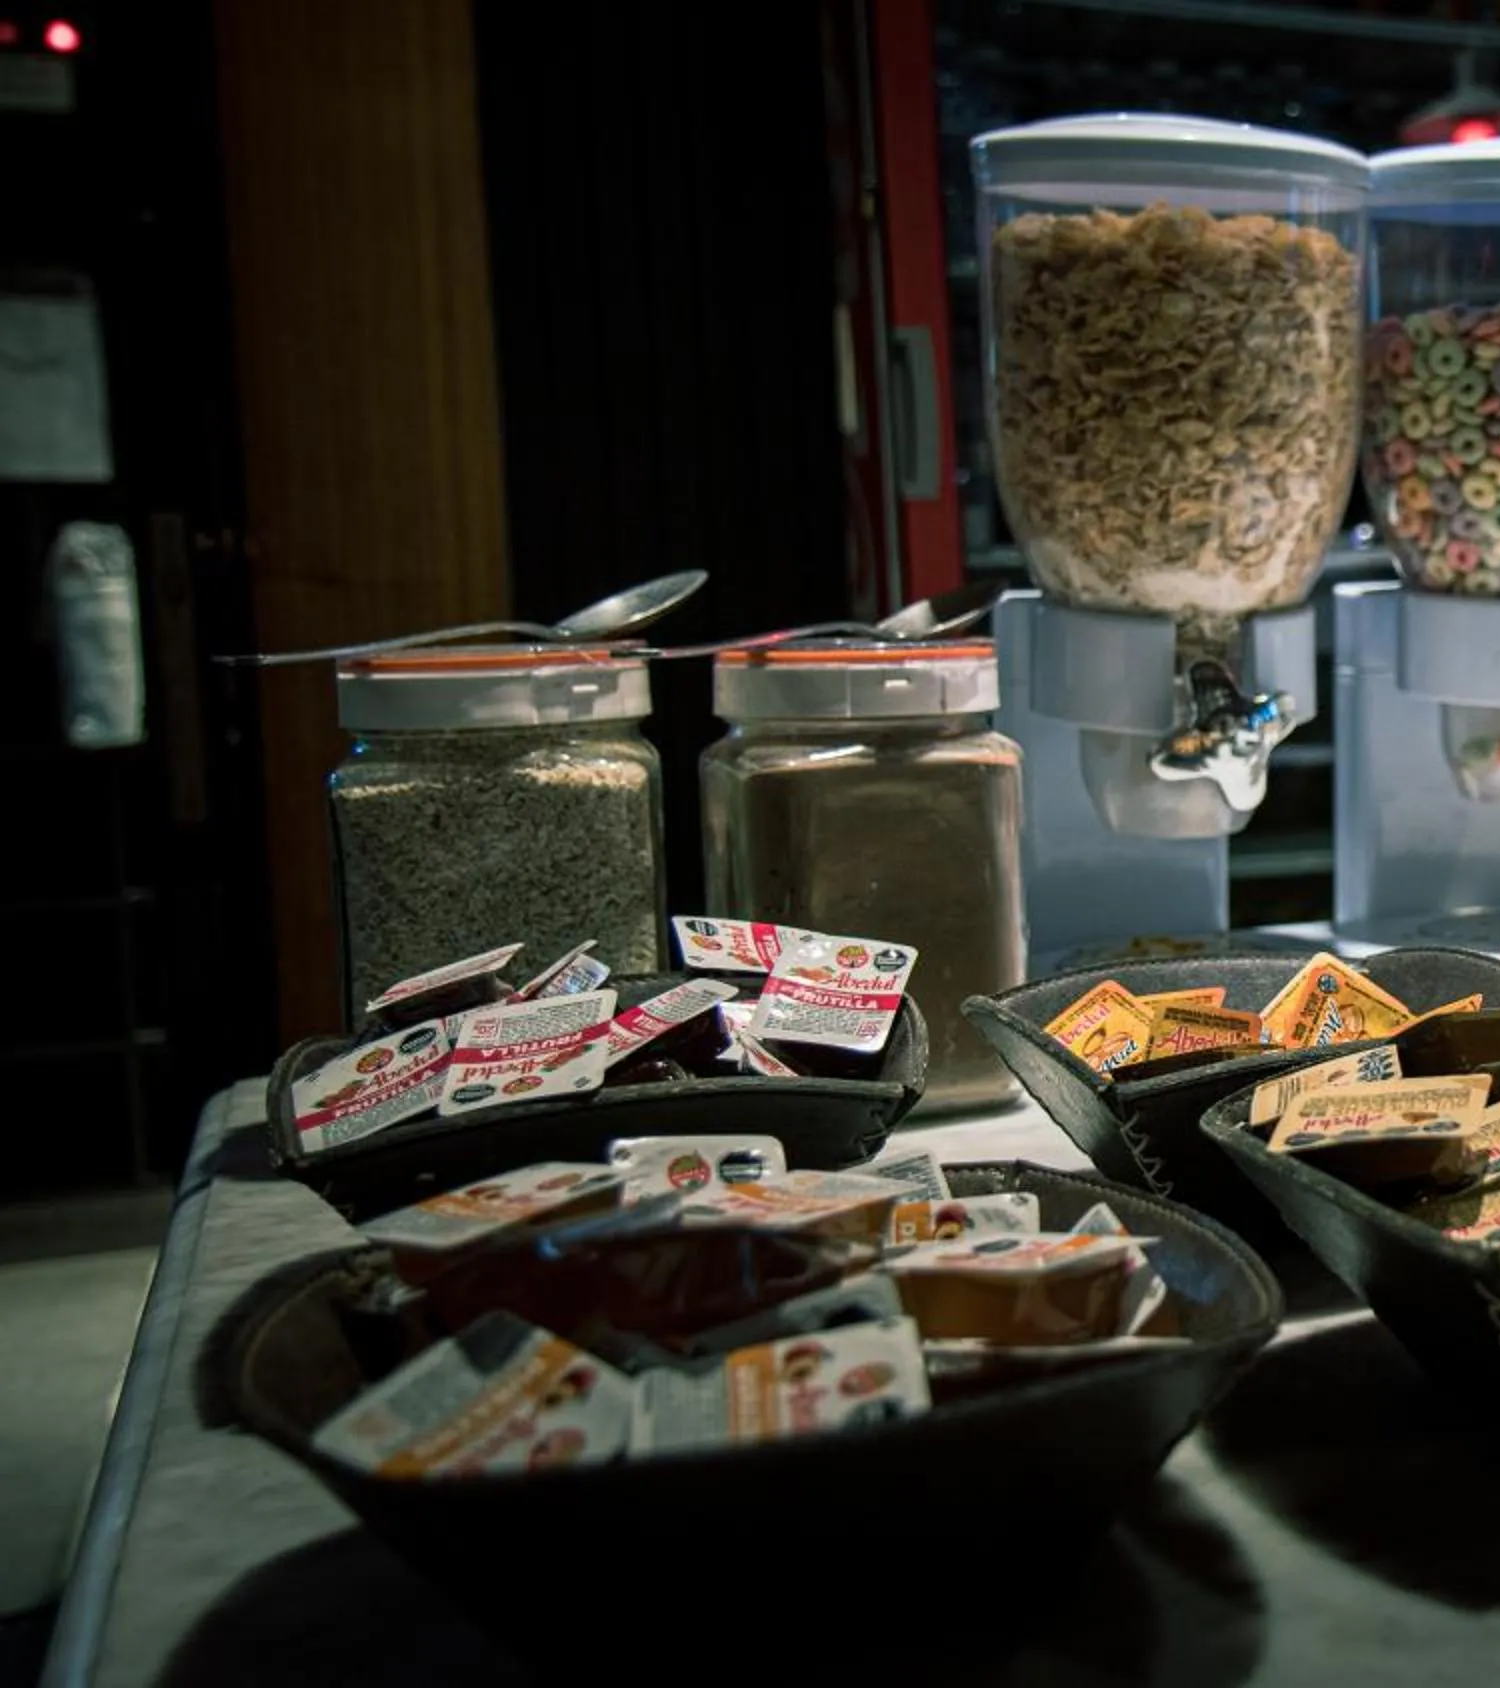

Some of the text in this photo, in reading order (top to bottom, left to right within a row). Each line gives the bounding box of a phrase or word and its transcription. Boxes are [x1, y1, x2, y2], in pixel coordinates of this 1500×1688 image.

[824, 970, 897, 991] Abedul
[793, 987, 879, 1009] FRUTILLA
[1059, 1003, 1110, 1043] bedul
[481, 1031, 583, 1057] FRUTILLA
